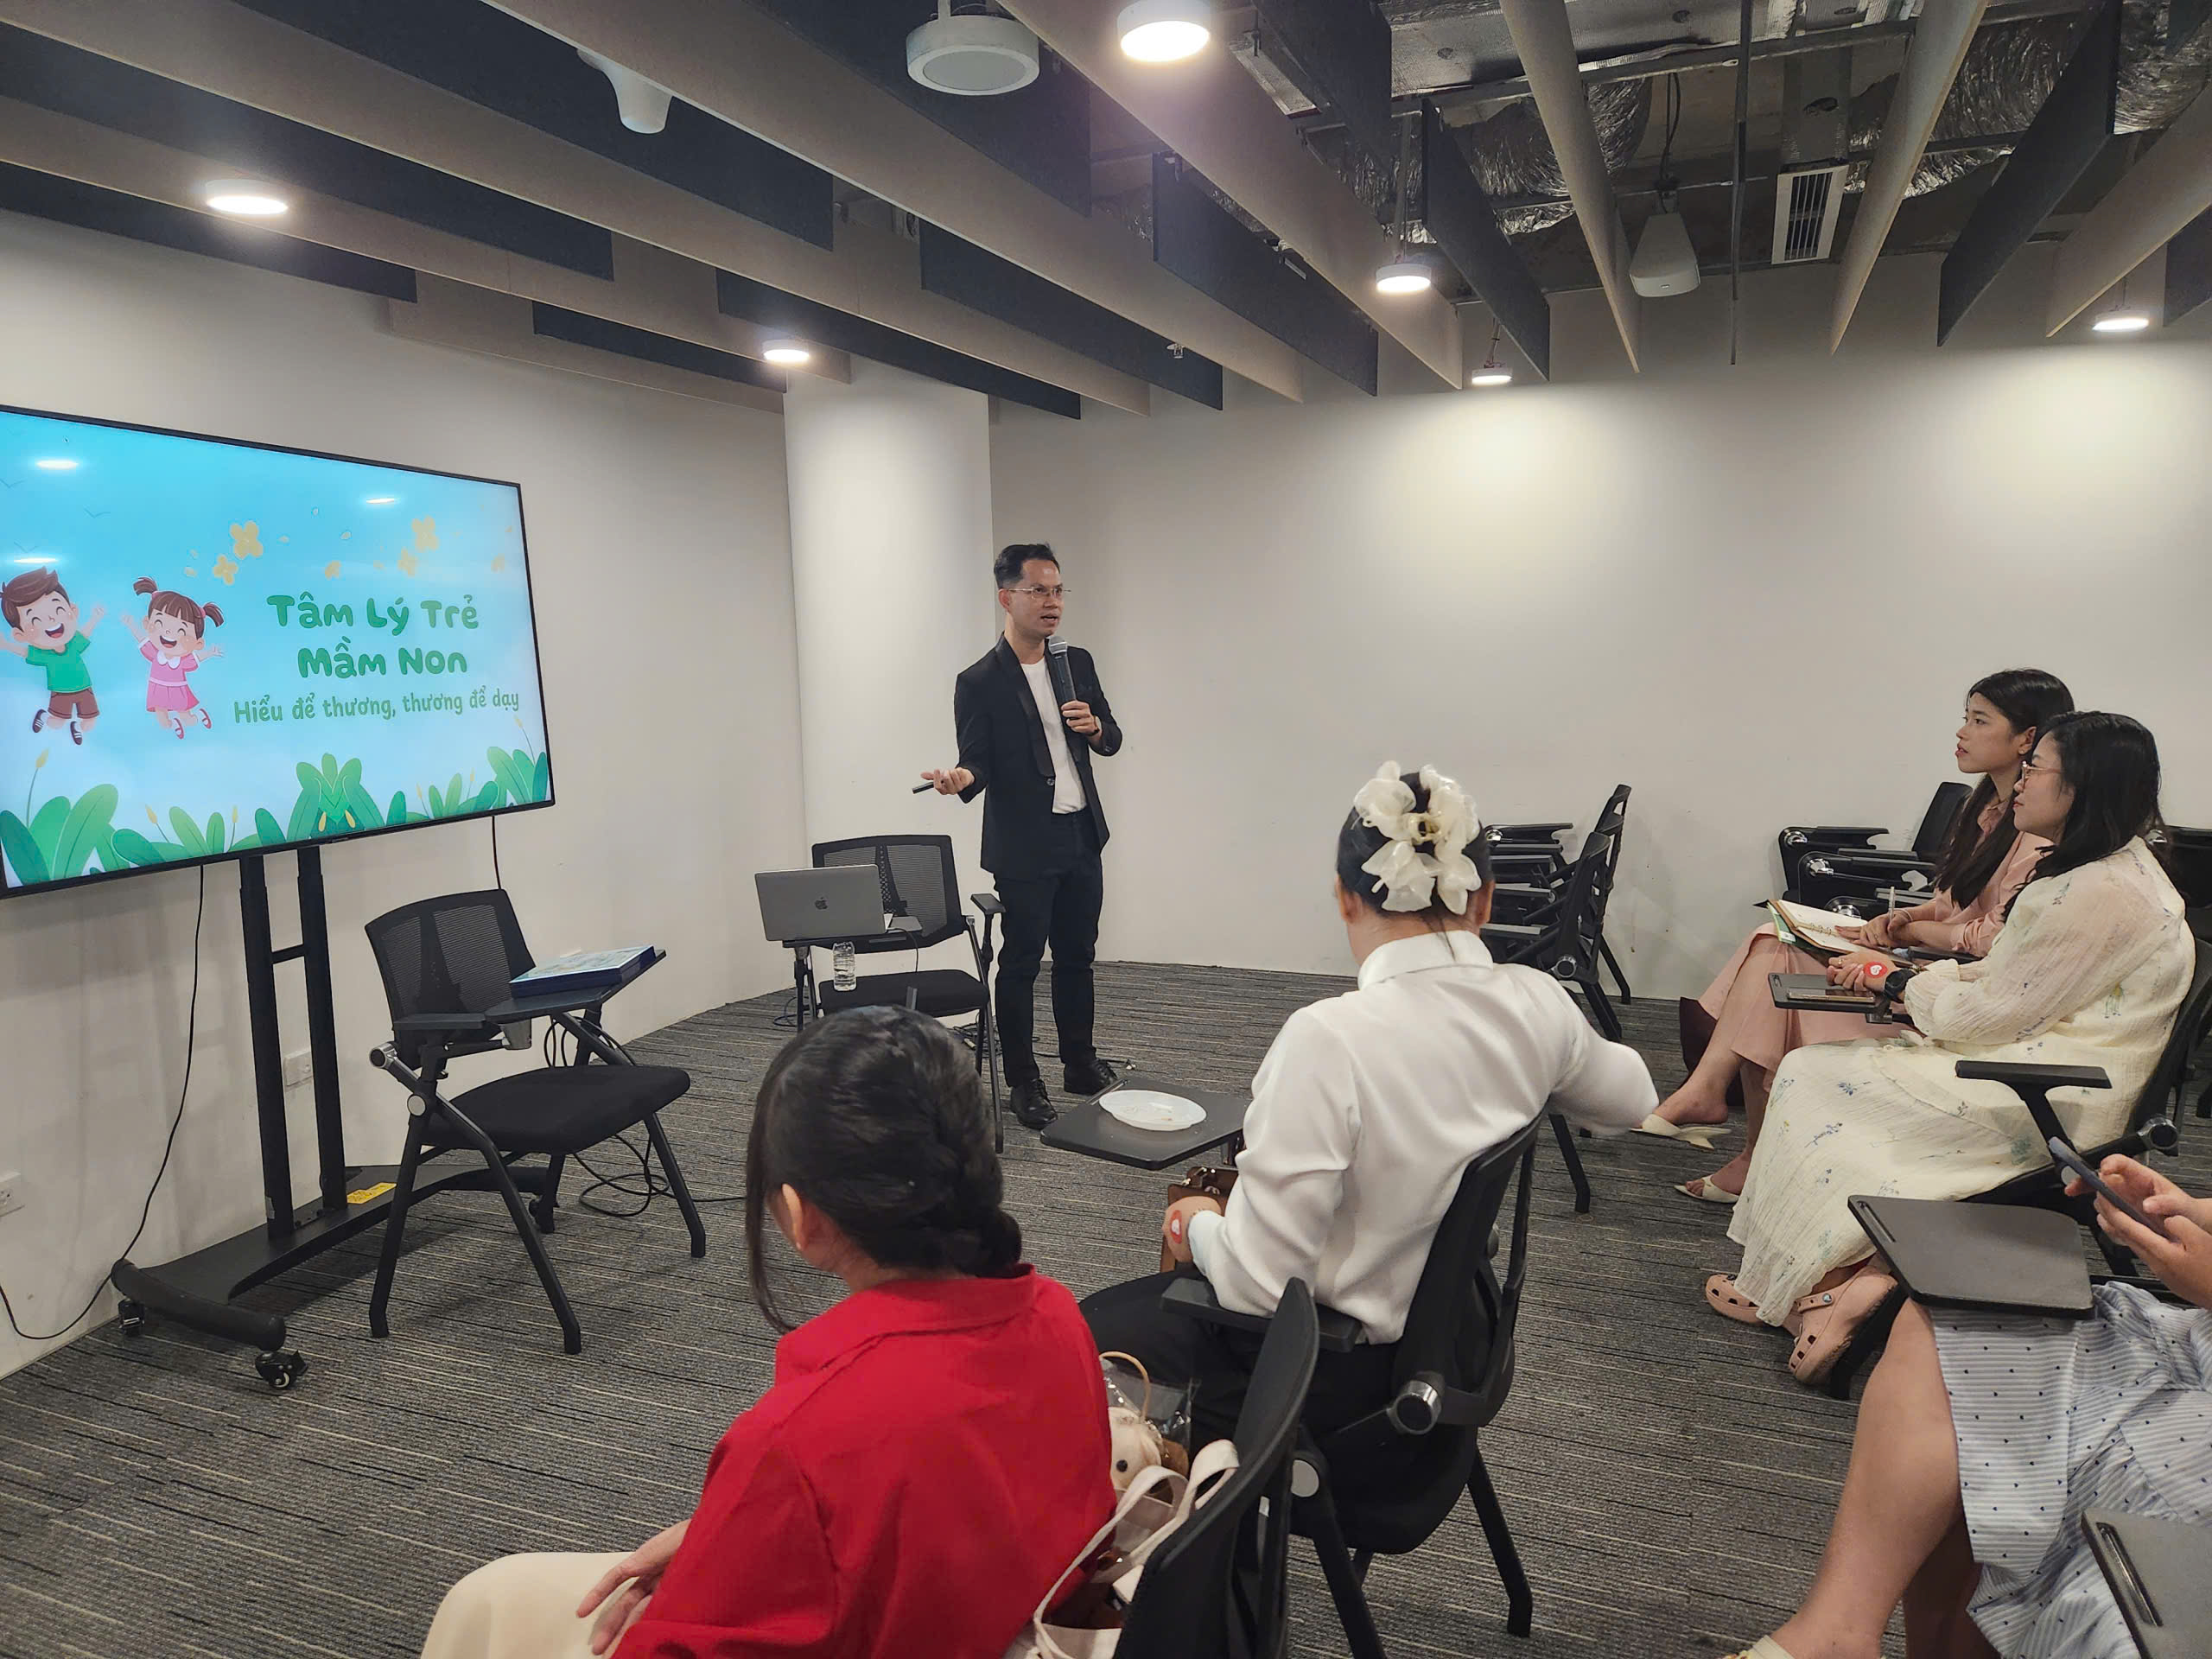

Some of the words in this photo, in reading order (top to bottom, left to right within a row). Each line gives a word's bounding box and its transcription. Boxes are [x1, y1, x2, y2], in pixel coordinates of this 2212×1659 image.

[266, 591, 354, 629] Tâm
[365, 596, 410, 637] Lý
[420, 594, 480, 630] Trẻ
[297, 635, 387, 679] Mầm
[397, 646, 468, 677] Non
[233, 694, 283, 723] Hiểu
[292, 692, 317, 721] để
[322, 695, 397, 721] thương,
[402, 691, 464, 716] thương
[468, 684, 487, 709] để
[492, 687, 520, 712] dạy
